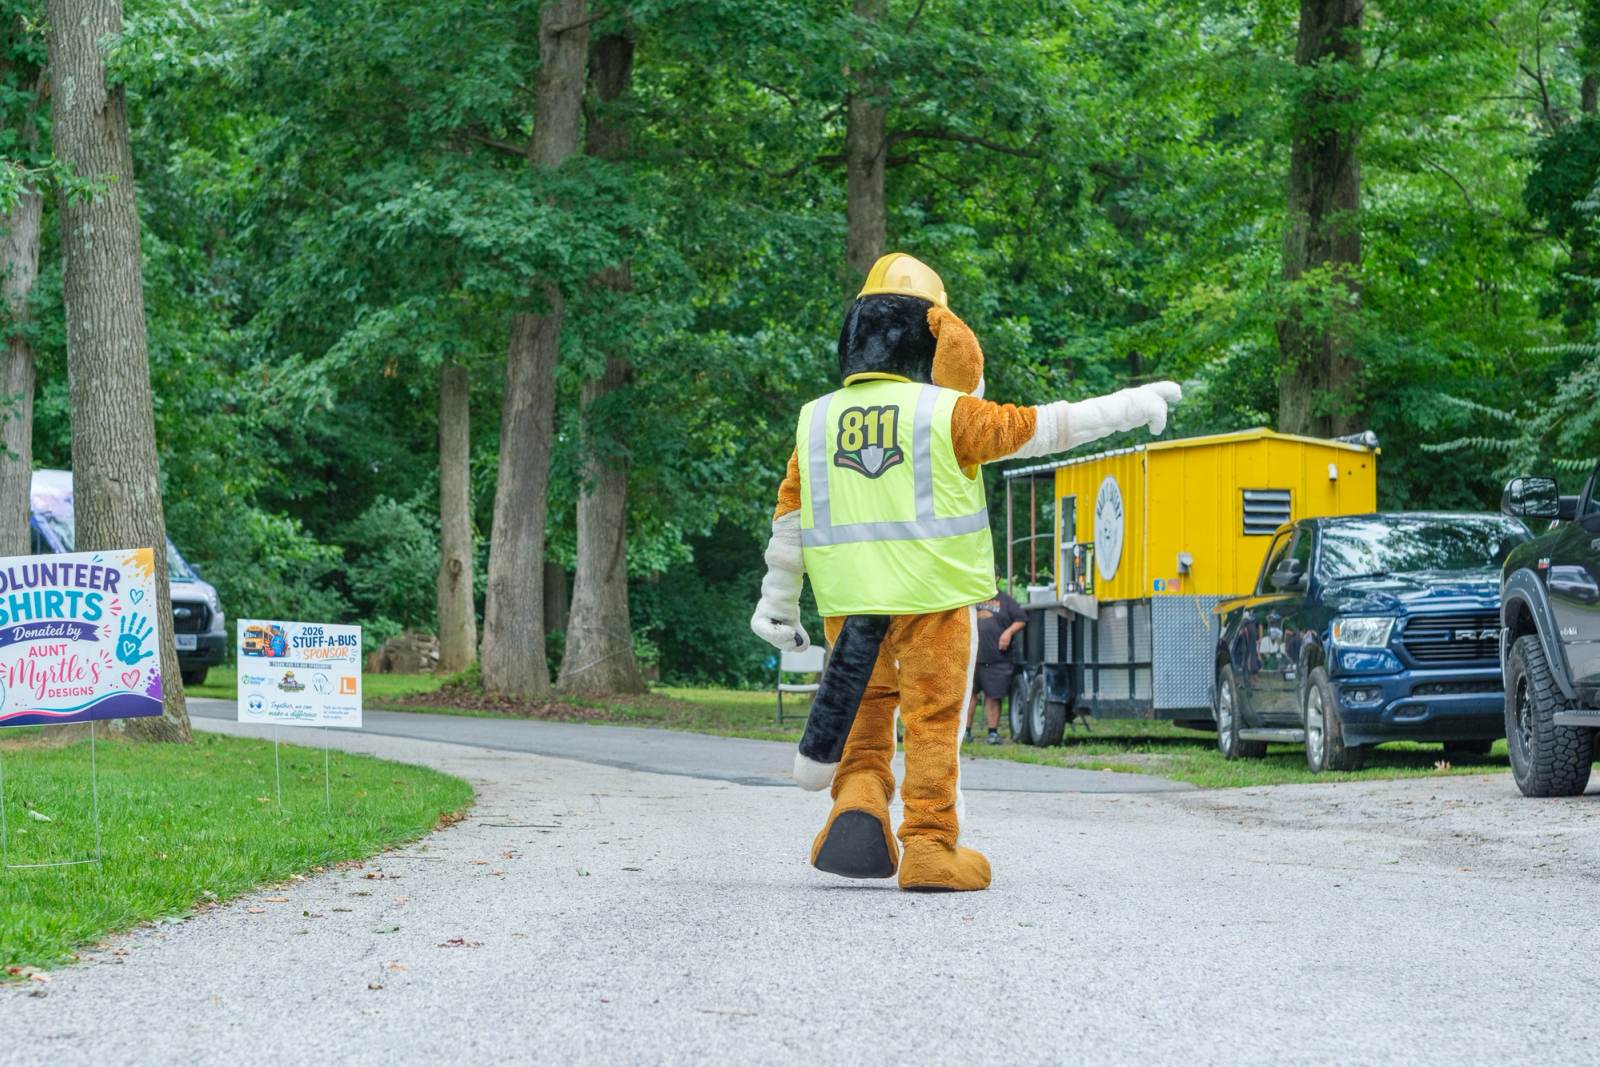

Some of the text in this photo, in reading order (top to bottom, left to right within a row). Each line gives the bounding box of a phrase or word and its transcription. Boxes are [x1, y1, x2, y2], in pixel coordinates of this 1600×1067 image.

[841, 409, 895, 451] 811
[0, 562, 121, 594] OLUNTEER
[13, 623, 82, 641] Donated by
[302, 626, 324, 636] 2026
[1455, 629, 1499, 641] RA
[292, 635, 357, 649] STUFF-A-BUS
[28, 644, 68, 658] AUNT
[303, 647, 349, 660] SPONSOR
[8, 654, 101, 700] Myrtle's
[48, 686, 94, 698] DESIGNS
